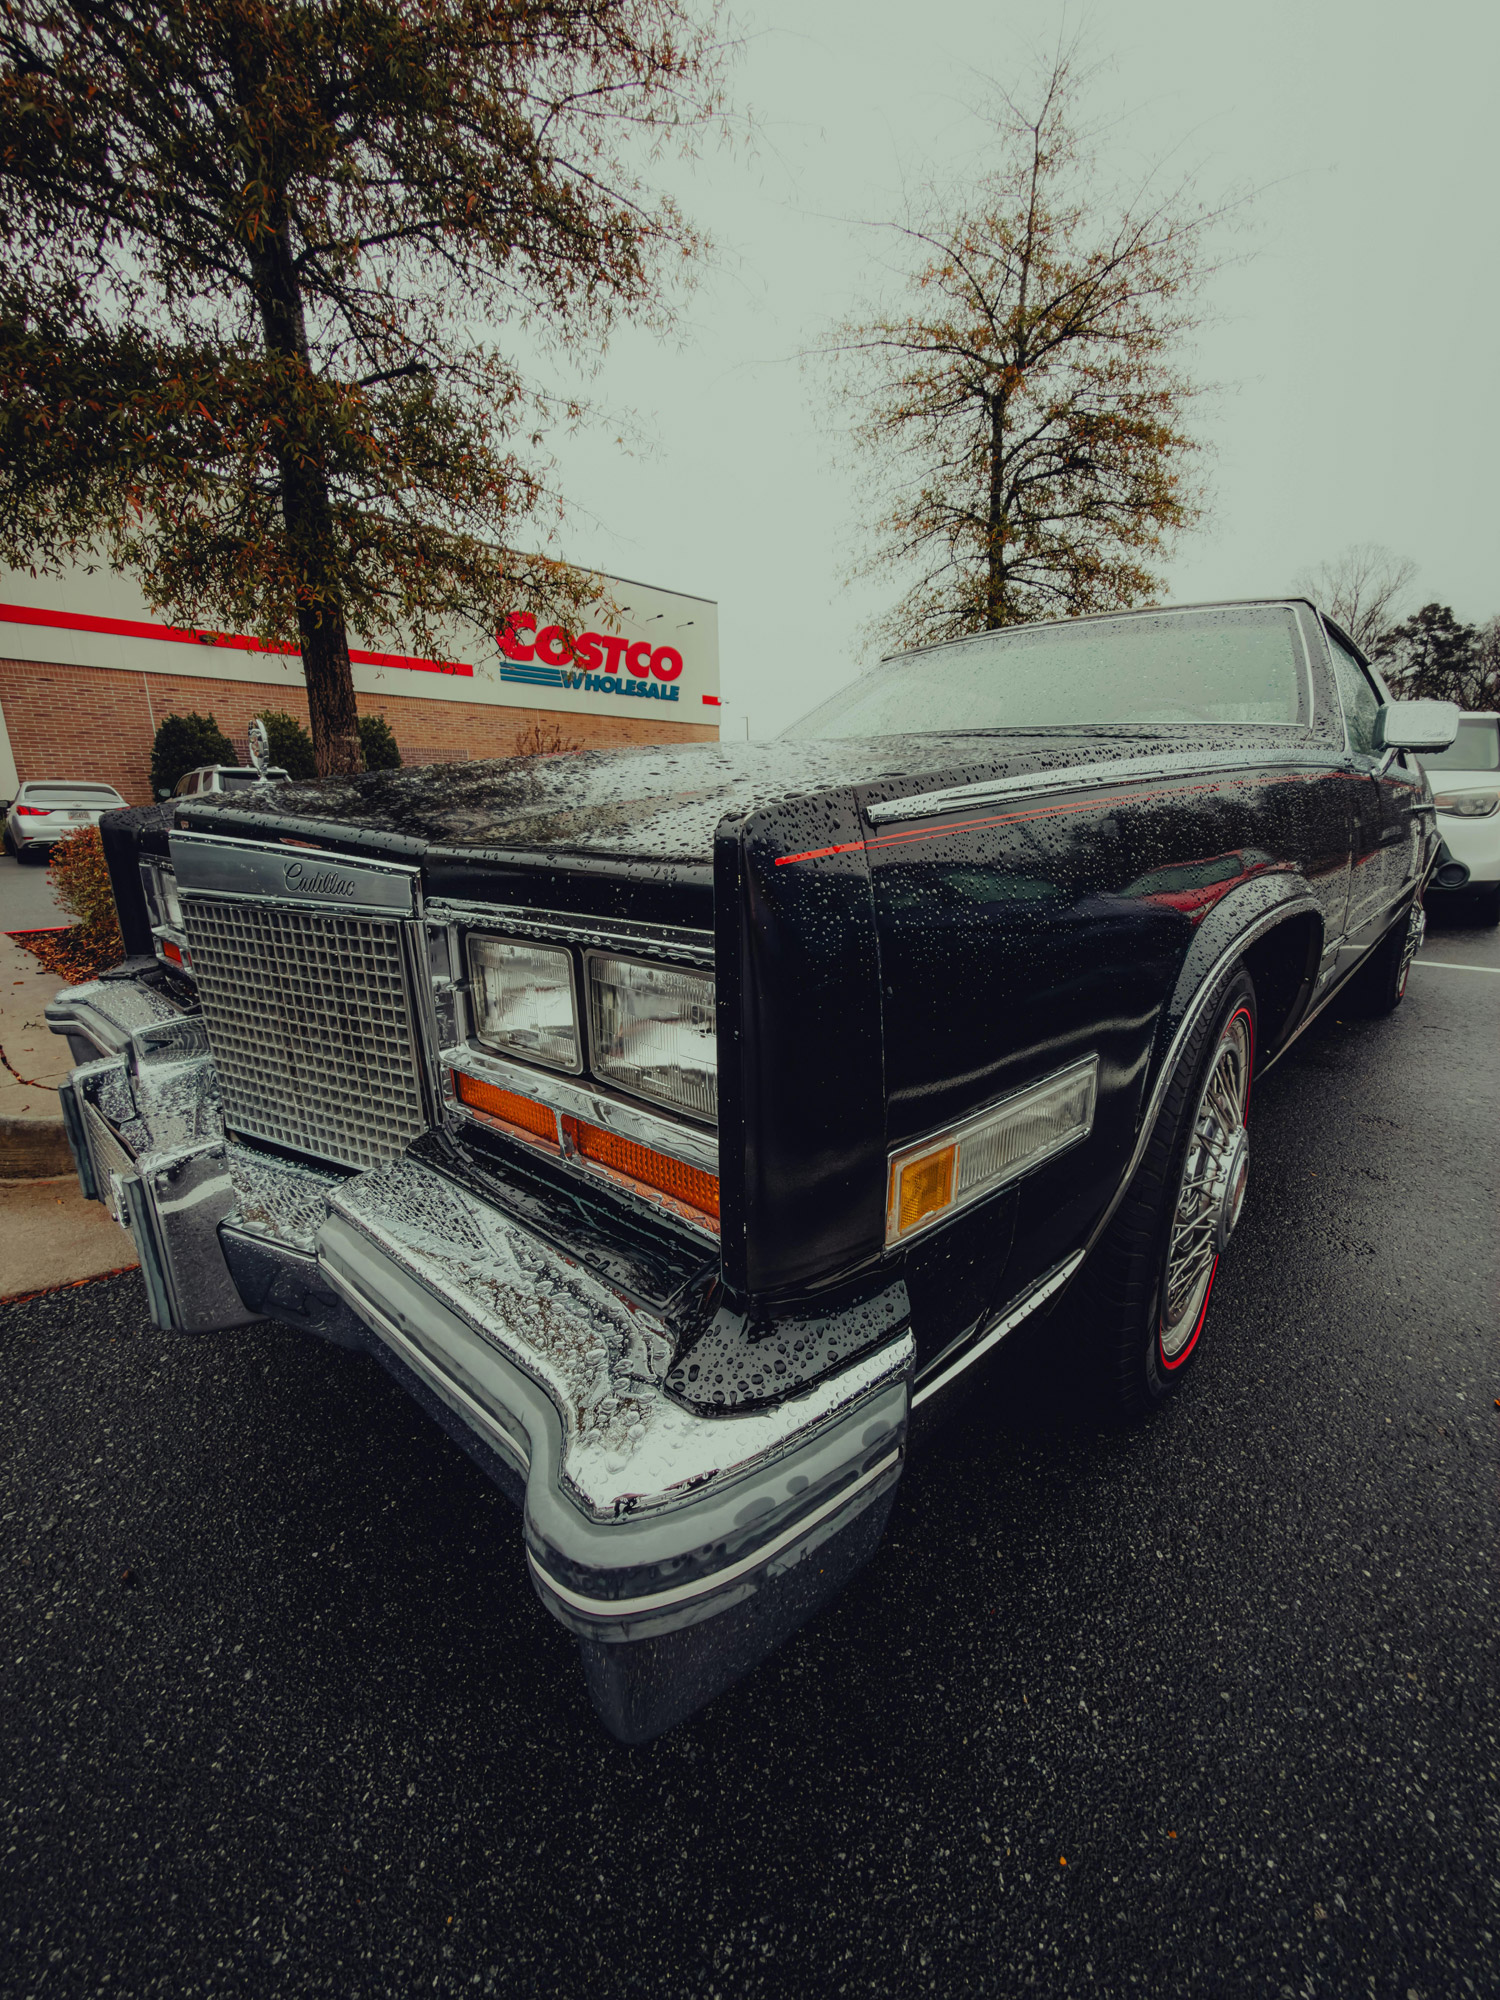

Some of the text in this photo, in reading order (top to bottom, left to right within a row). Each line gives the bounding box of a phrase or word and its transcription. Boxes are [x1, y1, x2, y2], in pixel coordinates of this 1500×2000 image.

[495, 610, 683, 682] COSTCO
[561, 670, 680, 701] WHOLESALE
[283, 862, 355, 897] Cadillac
